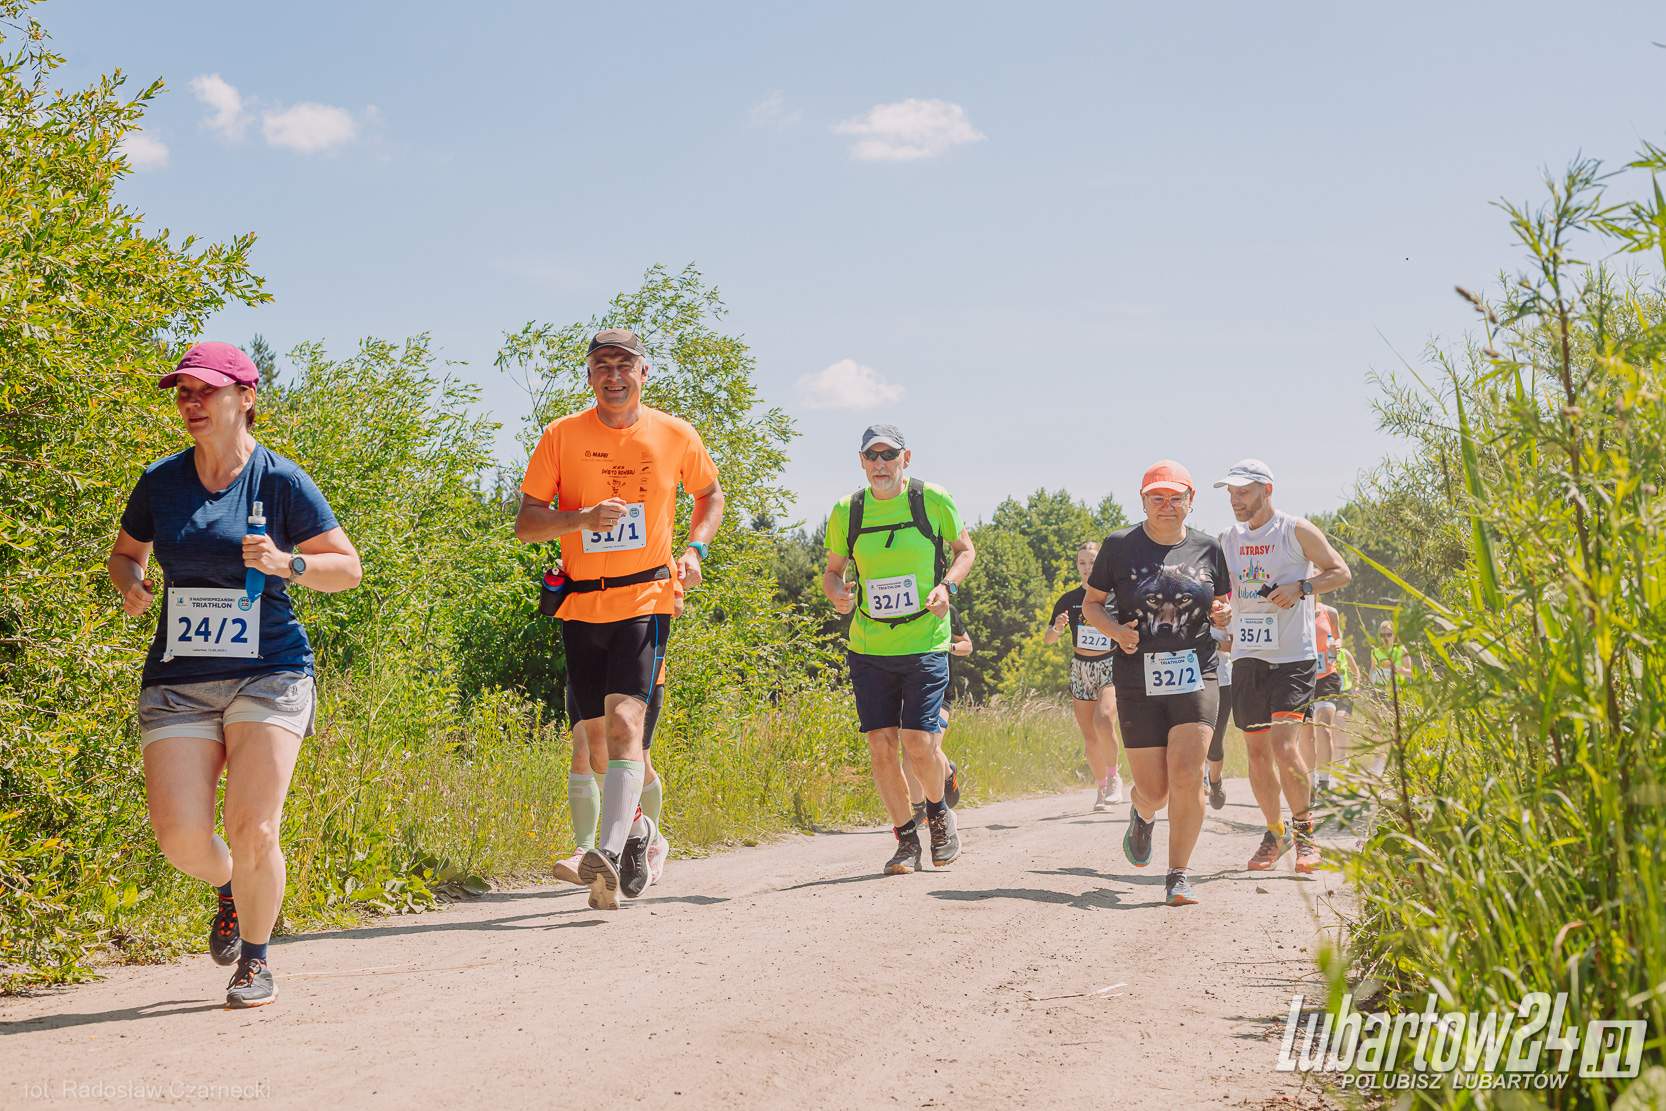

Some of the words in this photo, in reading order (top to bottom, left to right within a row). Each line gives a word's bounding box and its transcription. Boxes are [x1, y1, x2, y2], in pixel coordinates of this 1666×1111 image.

[873, 592, 913, 610] 32/1
[177, 616, 248, 644] 24/2
[1240, 628, 1273, 643] 35/1
[1081, 635, 1108, 646] 22/2
[1152, 667, 1196, 687] 32/2
